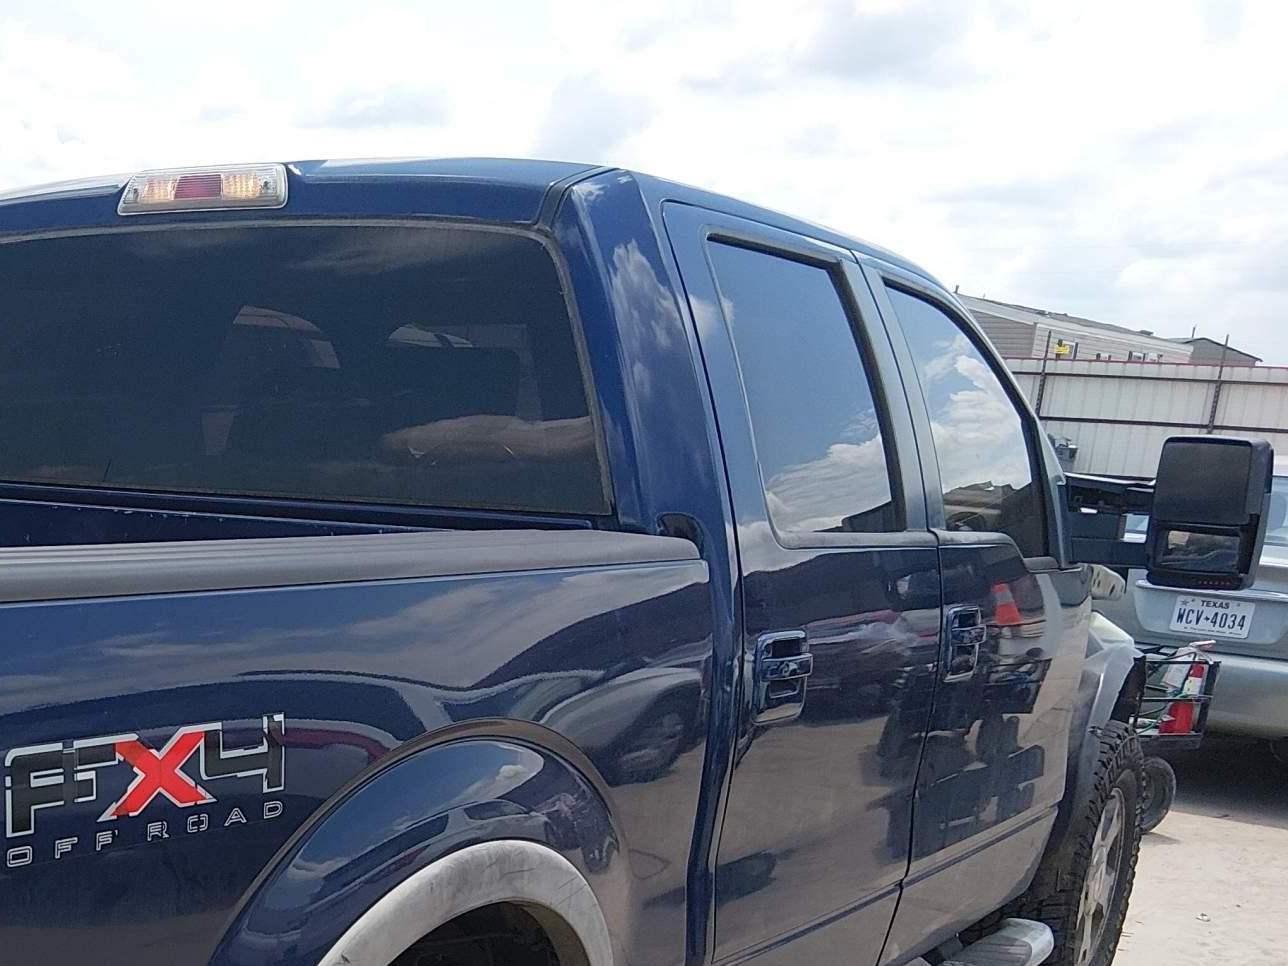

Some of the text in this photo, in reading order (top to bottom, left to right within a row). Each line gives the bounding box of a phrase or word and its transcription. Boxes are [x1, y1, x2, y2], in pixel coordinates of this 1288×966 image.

[1200, 599, 1230, 610] TEXAS
[6, 800, 284, 867] OFF ROAD
